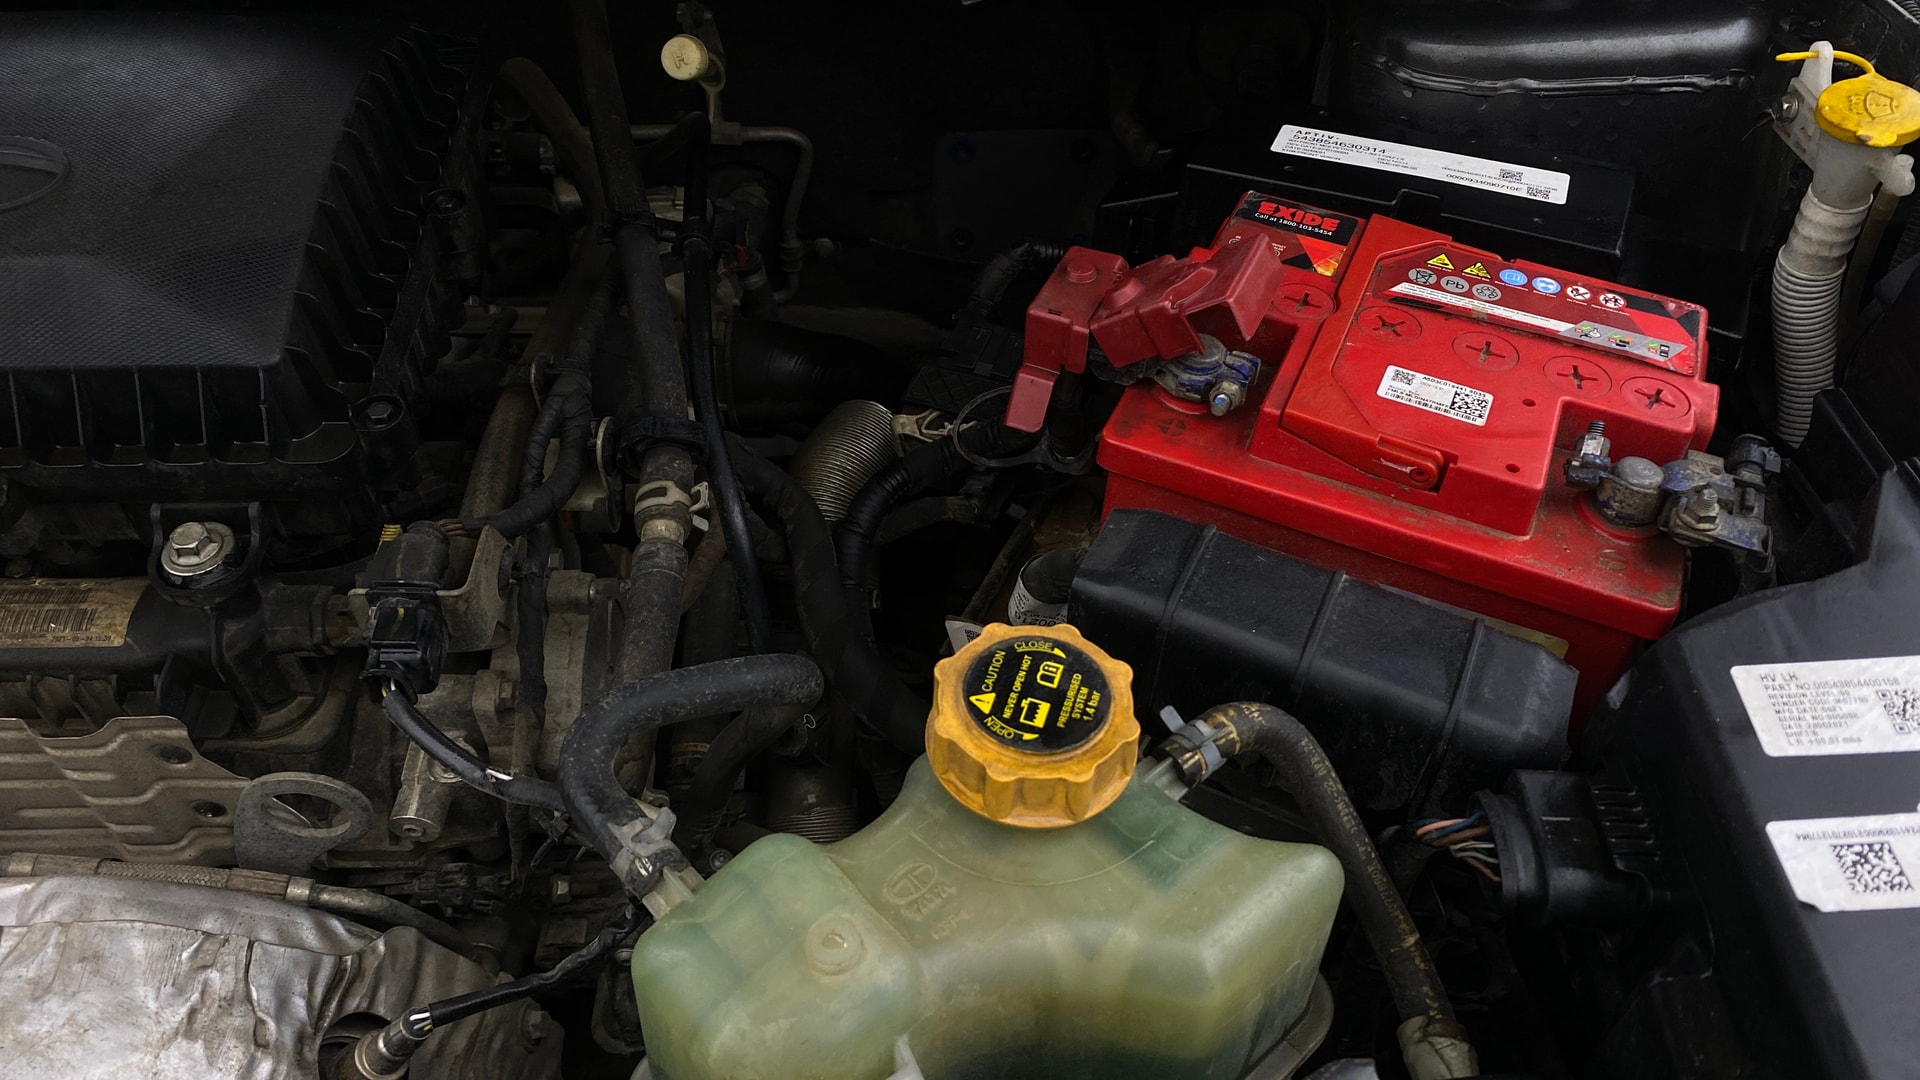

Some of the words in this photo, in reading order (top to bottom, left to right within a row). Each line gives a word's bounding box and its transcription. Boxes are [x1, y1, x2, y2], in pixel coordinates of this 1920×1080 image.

[1254, 212, 1268, 220] Call
[1279, 219, 1332, 236] 1800-103-5454
[1258, 201, 1340, 231] EXIDE
[1446, 279, 1465, 290] Pb
[1014, 640, 1053, 650] CLOSE
[981, 650, 1006, 692] CAUTION
[1759, 673, 1776, 682] HV
[1002, 692, 1019, 719] NEVER
[1012, 670, 1027, 692] OPEN
[1020, 654, 1033, 671] HOT
[1763, 682, 1792, 691] PART
[1056, 673, 1082, 728] PRESSURISED
[1071, 686, 1090, 719] SYSTEM
[1087, 690, 1101, 707] bar
[983, 716, 1015, 739] OPEN
